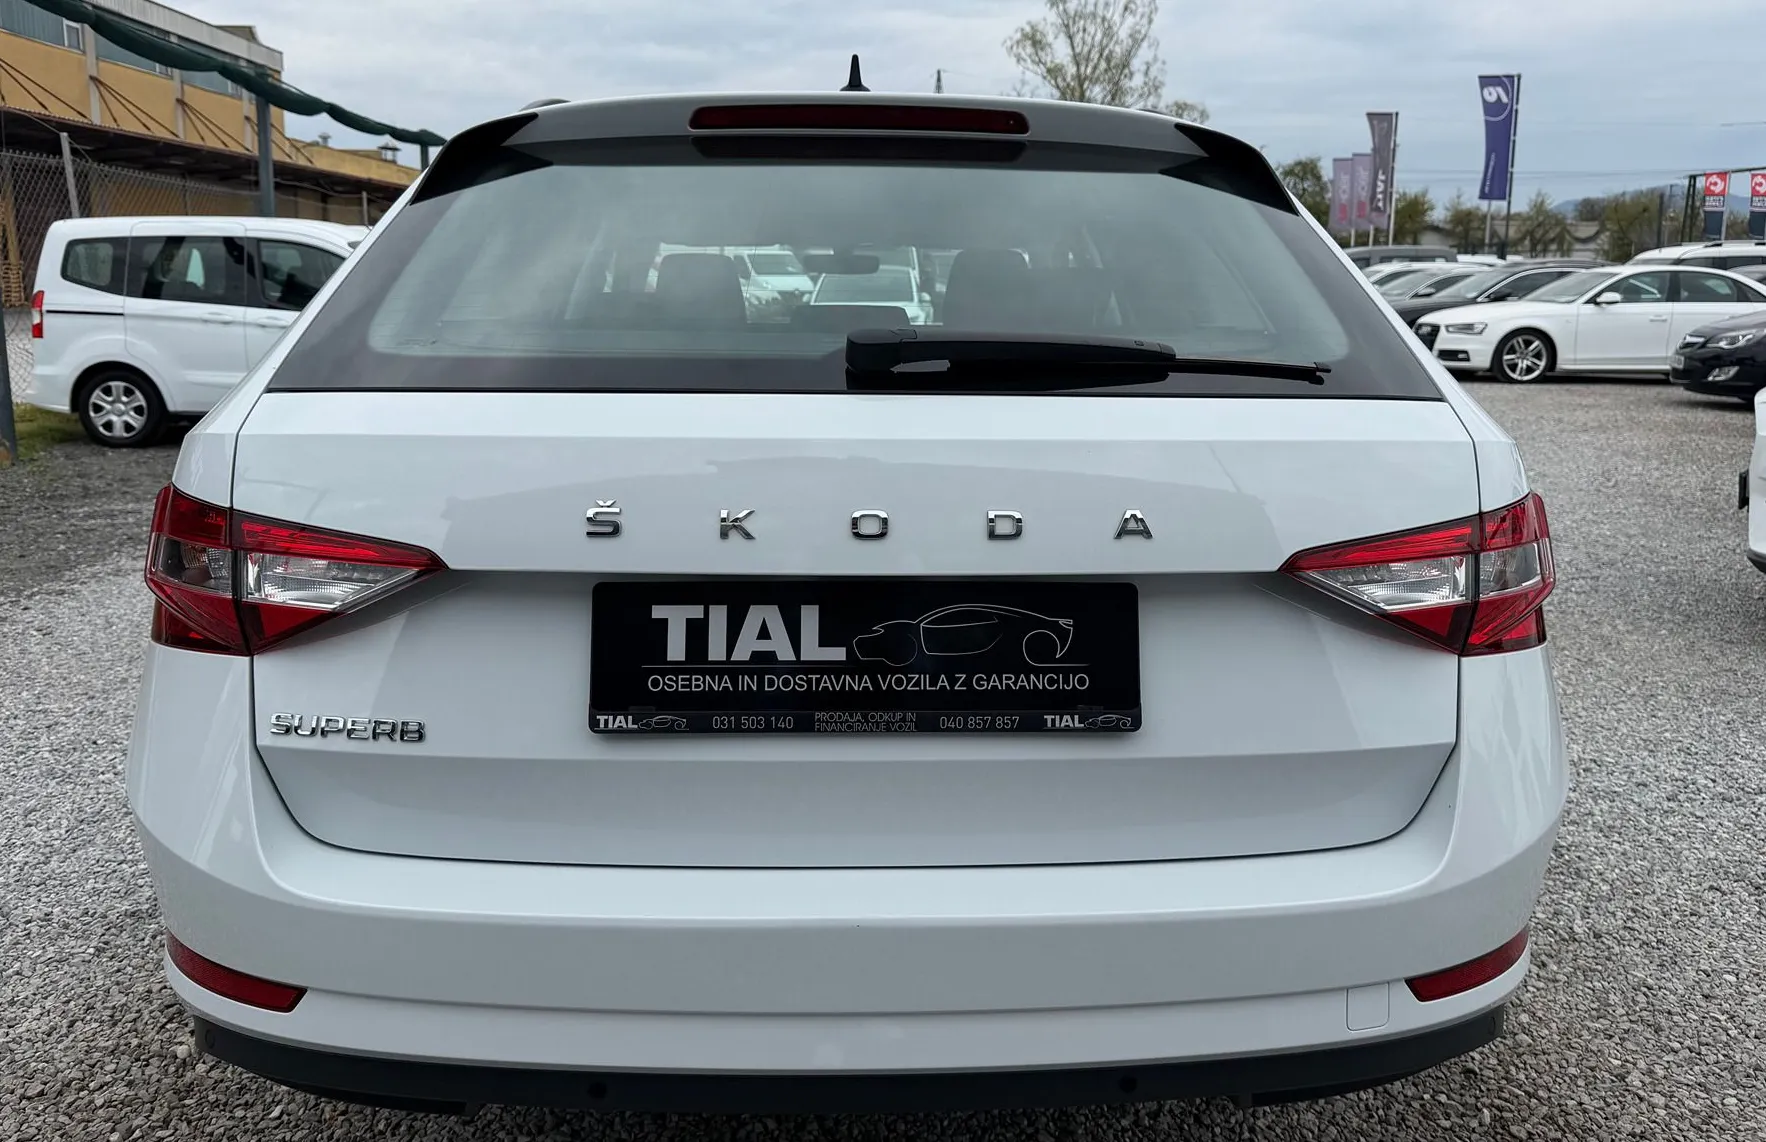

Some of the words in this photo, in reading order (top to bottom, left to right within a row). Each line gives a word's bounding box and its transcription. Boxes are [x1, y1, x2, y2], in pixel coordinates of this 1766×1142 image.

[585, 498, 1154, 541] ŠKODA
[651, 605, 847, 662] TIAL
[647, 674, 733, 692] OSEBNA
[738, 674, 757, 691] IN
[764, 674, 873, 692] DOSTAVNA
[877, 674, 950, 691] VOZILA
[954, 673, 967, 690] Z
[972, 673, 1090, 690] GARANCIJO
[596, 715, 638, 729] TIAL
[712, 716, 735, 729] 031
[741, 716, 765, 729] 503
[770, 716, 794, 729] 140
[814, 712, 865, 722] PRODAJA,
[868, 712, 903, 722] ODKUP
[906, 712, 916, 722] IN
[940, 716, 964, 729] 040
[967, 716, 992, 729] 857
[995, 716, 1020, 729] 857
[1043, 714, 1085, 728] TIAL
[269, 711, 425, 743] SUPERB
[814, 722, 887, 732] FINANCIRANJE
[889, 722, 917, 732] VOZIL
